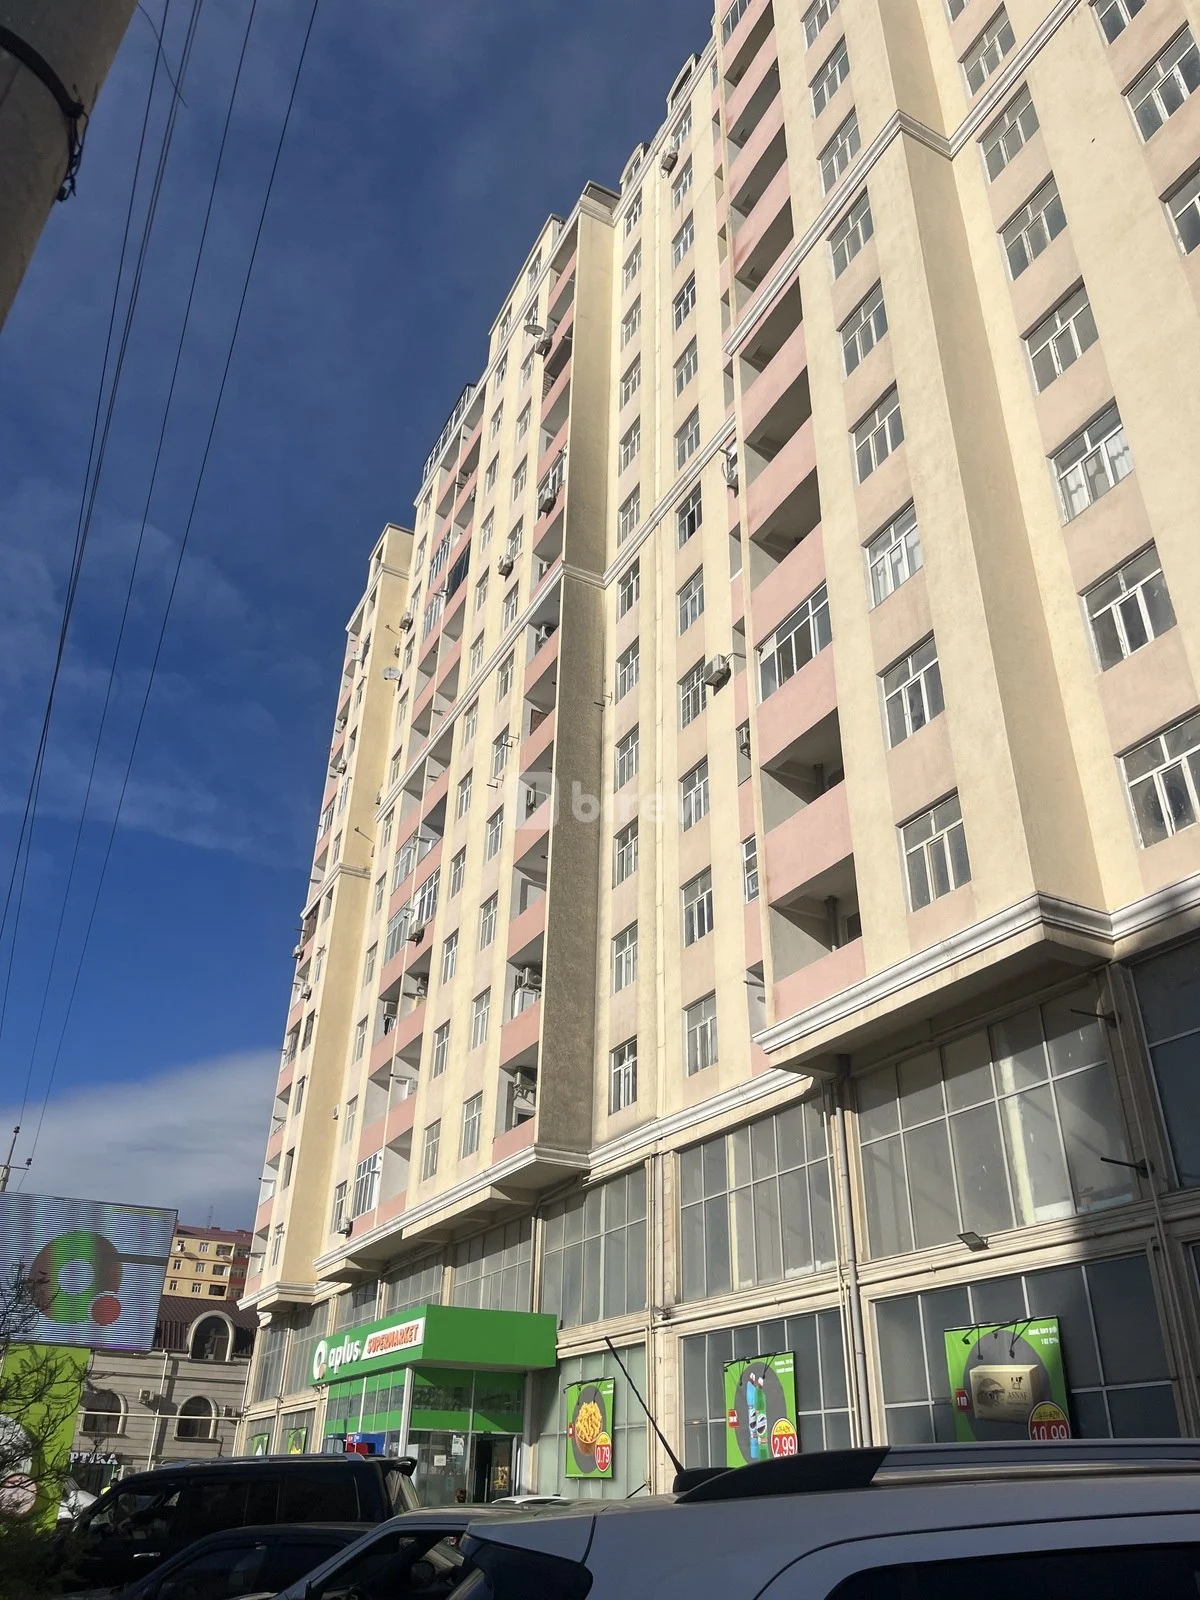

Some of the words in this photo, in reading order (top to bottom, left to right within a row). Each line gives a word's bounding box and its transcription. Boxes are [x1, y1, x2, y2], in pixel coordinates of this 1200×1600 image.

[328, 1335, 361, 1374] aplus
[366, 1323, 419, 1354] SUPERMARKET
[596, 1446, 610, 1463] 0.79
[774, 1436, 796, 1458] 2.99
